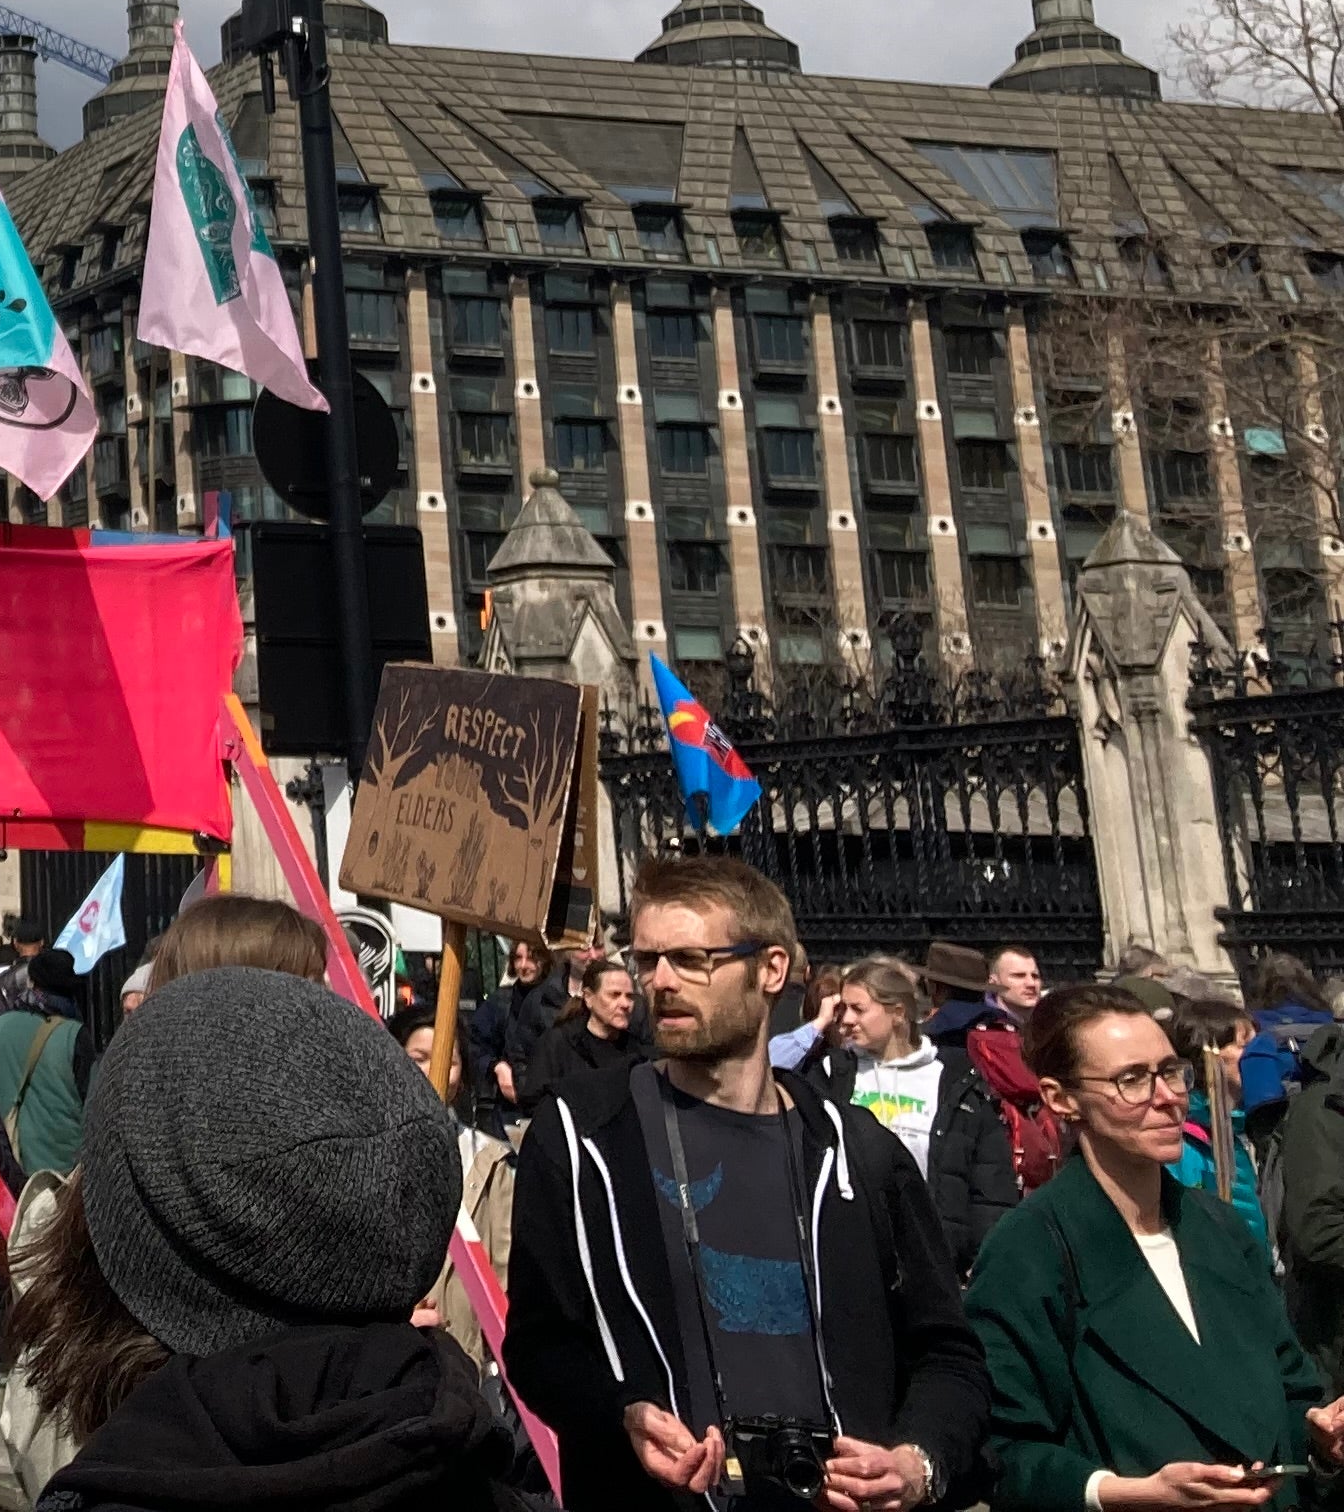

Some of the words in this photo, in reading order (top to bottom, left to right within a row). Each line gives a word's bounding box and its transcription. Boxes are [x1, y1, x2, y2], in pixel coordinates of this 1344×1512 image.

[444, 703, 526, 760] RESPECT
[435, 752, 483, 804] YOUR
[396, 792, 456, 833] ELDERS
